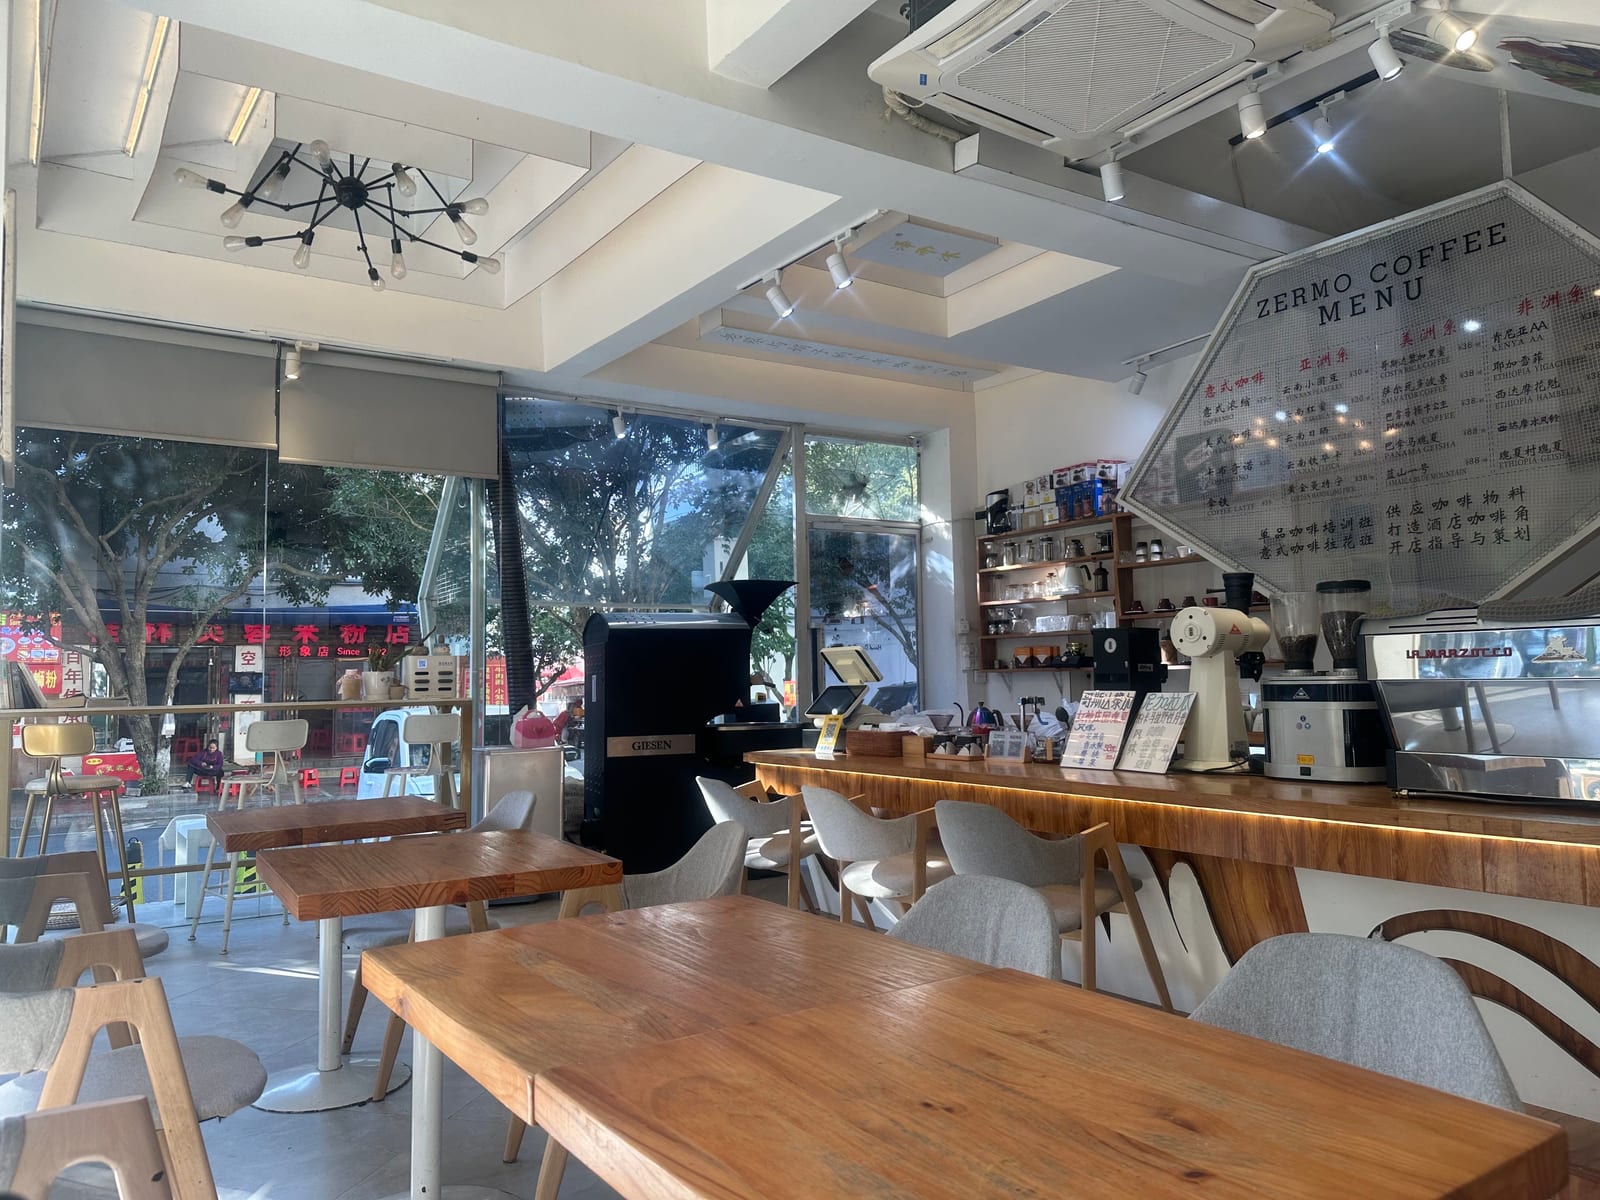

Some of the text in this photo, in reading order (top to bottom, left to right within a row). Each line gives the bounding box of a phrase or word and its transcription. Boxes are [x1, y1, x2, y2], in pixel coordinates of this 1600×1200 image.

[1257, 222, 1507, 319] ZERMO COFFEE
[1318, 277, 1425, 325] MENU
[1517, 284, 1584, 317] 非洲系
[1400, 319, 1457, 347] 美洲系
[1300, 347, 1348, 371] 亚洲系
[1205, 370, 1264, 398] 意式咖啡
[1386, 485, 1526, 519] 供应咖啡物料
[1259, 516, 1374, 542] 单品咖啡培训班
[1387, 505, 1530, 537] 打造酒店咖啡角
[1259, 534, 1374, 560] 意式咖啡拉花班
[1388, 525, 1532, 556] 开店指导与策划
[279, 645, 329, 657] 形象店
[337, 648, 360, 656] Since
[632, 739, 672, 752] GIESEN
